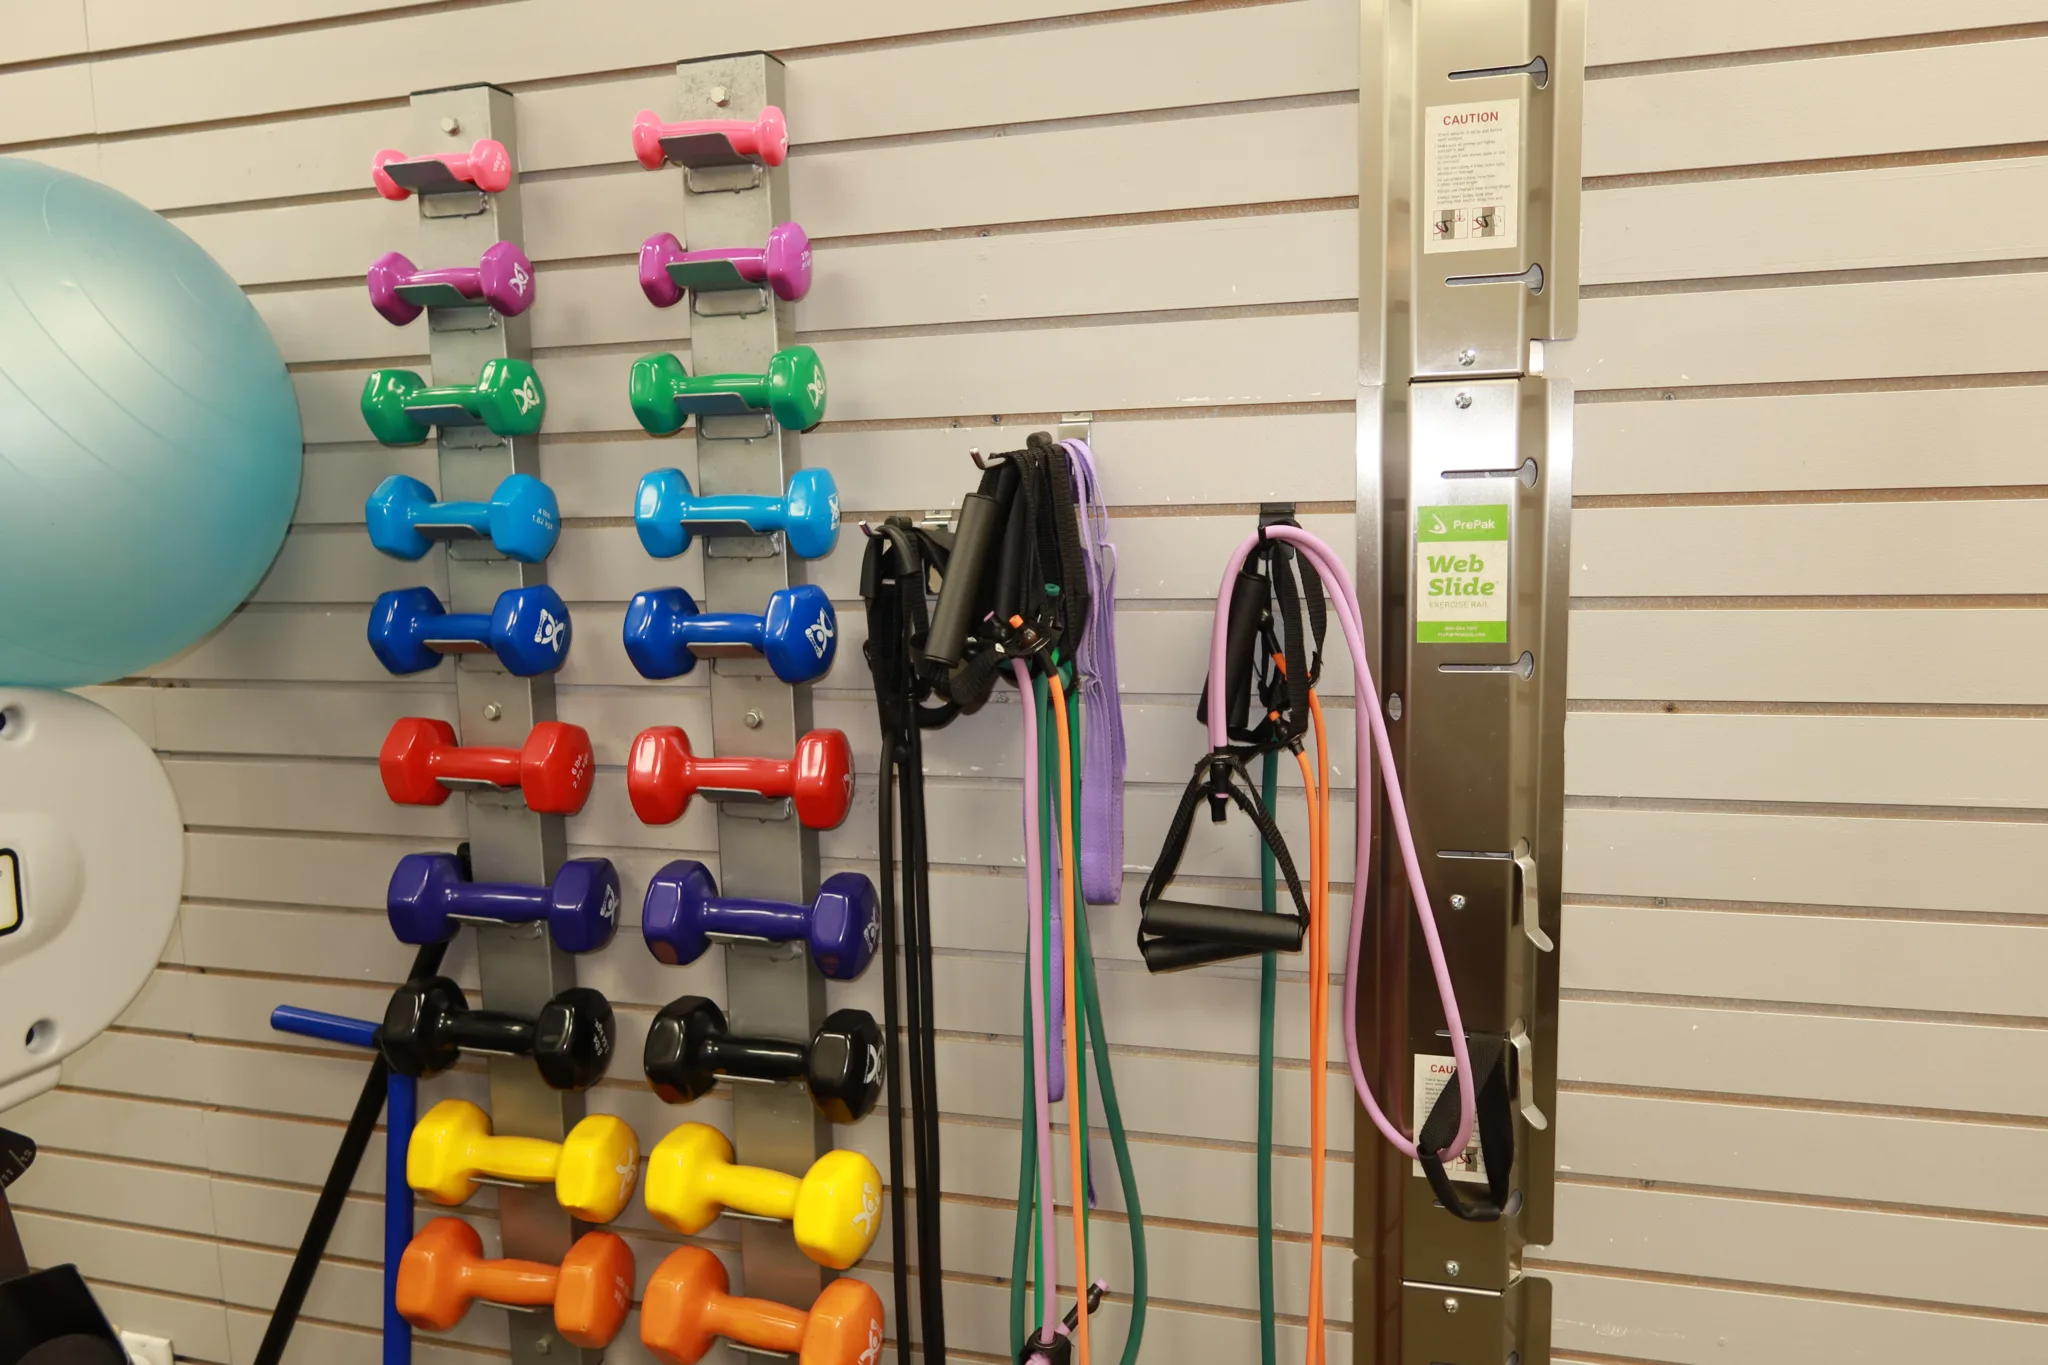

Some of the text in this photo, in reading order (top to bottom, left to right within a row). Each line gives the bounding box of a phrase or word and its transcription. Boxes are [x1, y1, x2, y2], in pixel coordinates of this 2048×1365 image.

[1443, 112, 1499, 125] CAUTION
[1453, 519, 1496, 530] PrePak
[1427, 554, 1484, 573] Web
[1428, 577, 1495, 596] Slide
[1429, 601, 1489, 609] EXERCISE RAIL
